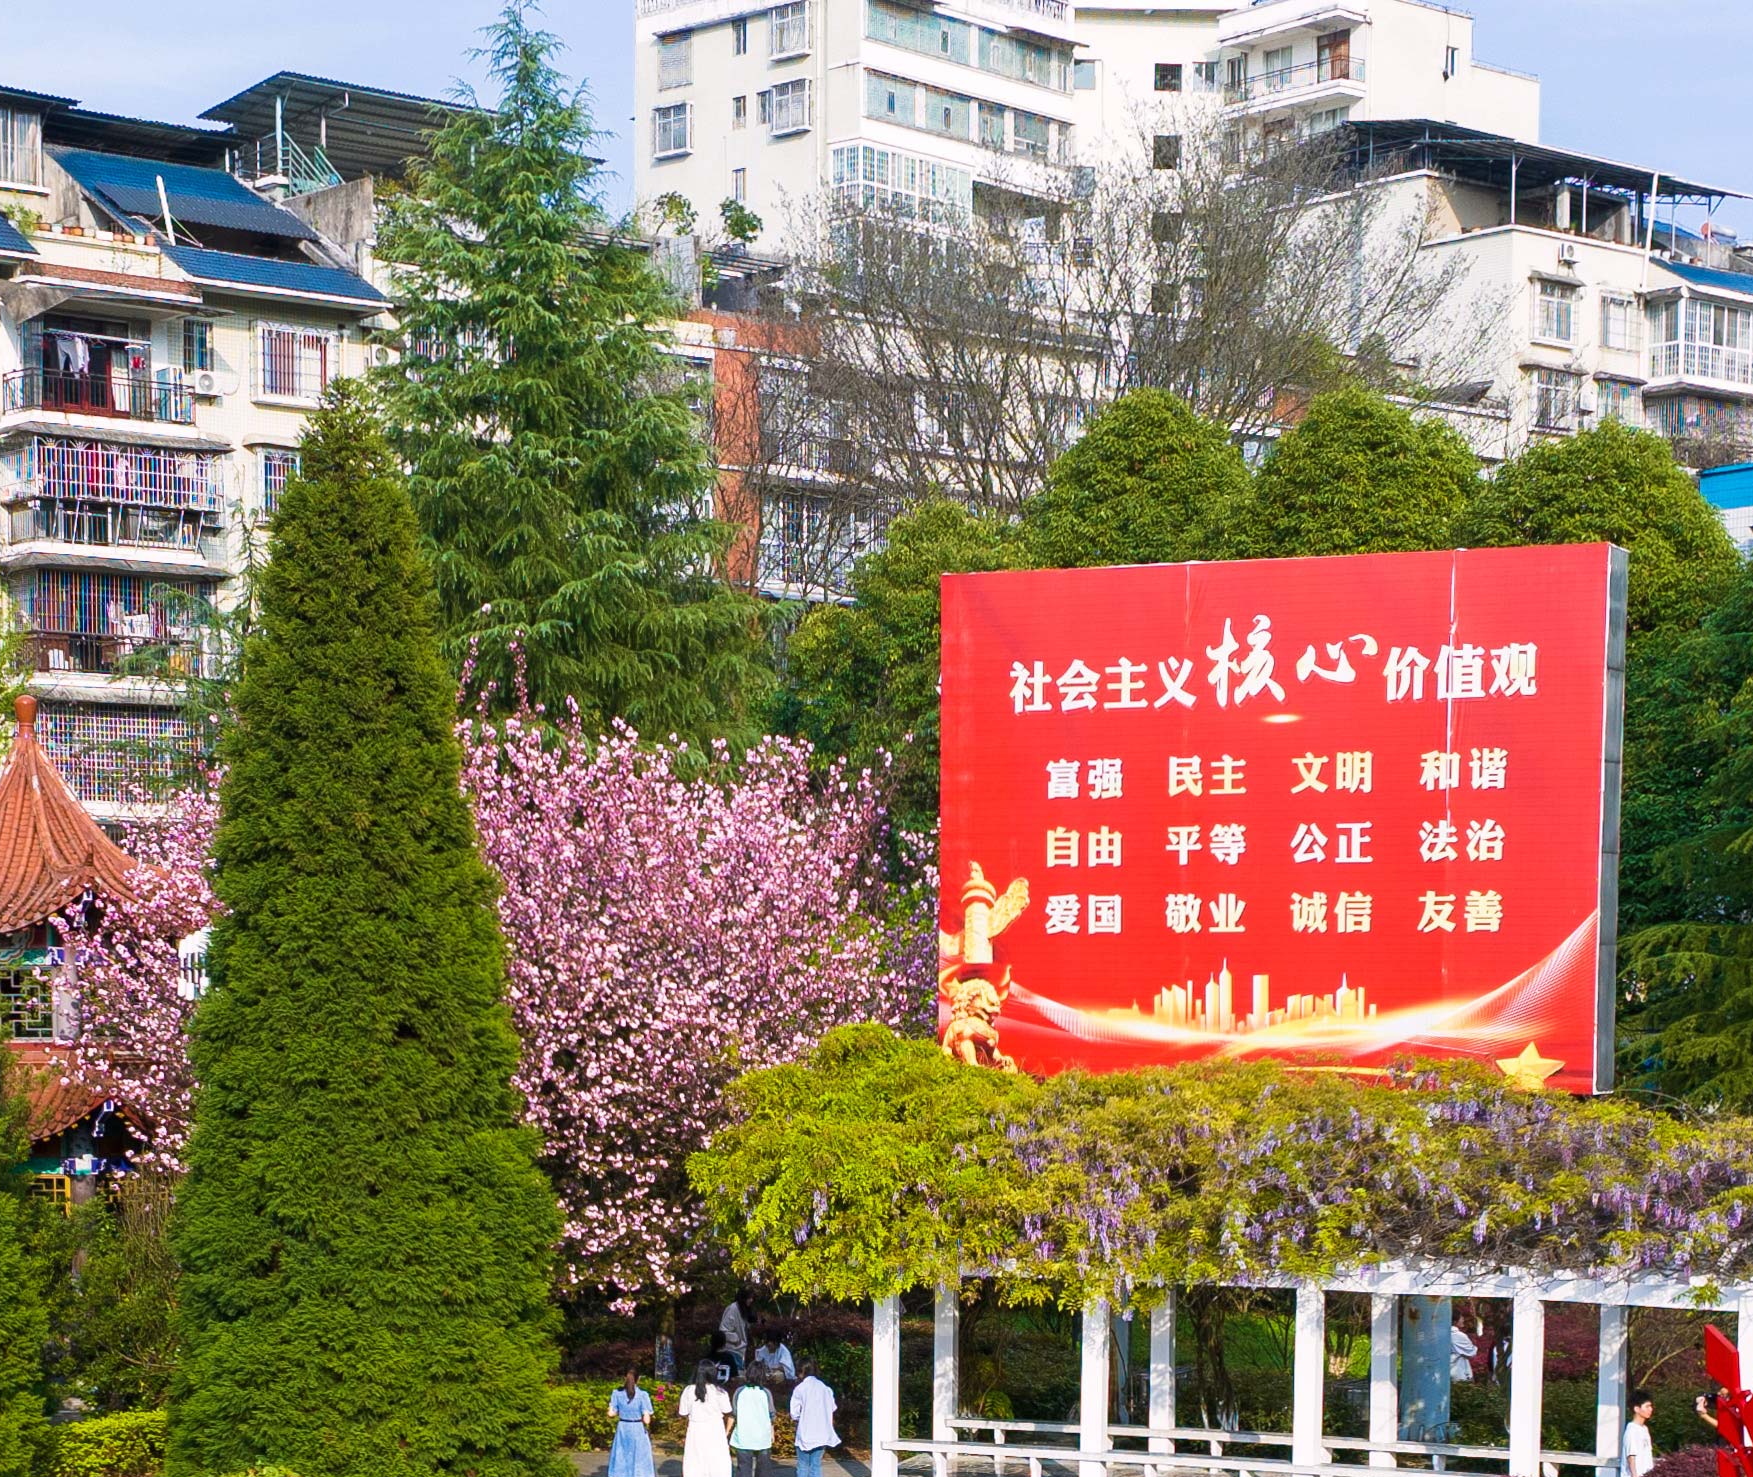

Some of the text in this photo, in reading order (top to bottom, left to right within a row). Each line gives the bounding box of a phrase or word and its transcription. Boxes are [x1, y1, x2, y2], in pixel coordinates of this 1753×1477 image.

[1009, 614, 1539, 714] 社会主义核心价值观
[1045, 748, 1509, 800] 富强 民主 文明 和谐
[1045, 819, 1506, 868] 自由 平等 公正 法治
[1045, 889, 1504, 935] 爱国 敬业 诚信 友善
